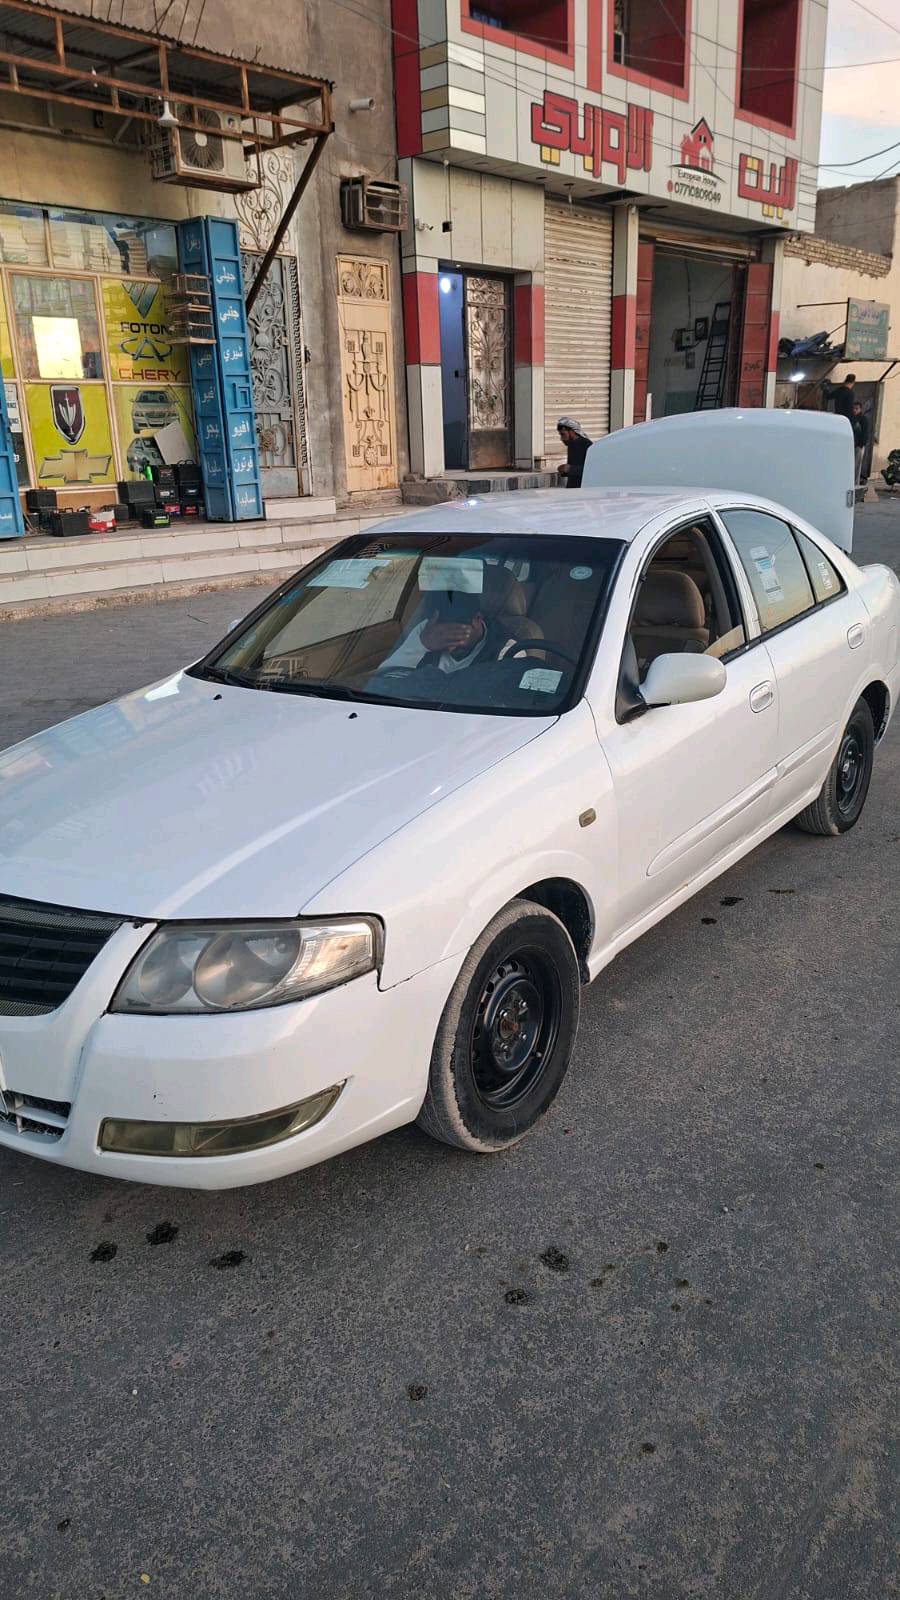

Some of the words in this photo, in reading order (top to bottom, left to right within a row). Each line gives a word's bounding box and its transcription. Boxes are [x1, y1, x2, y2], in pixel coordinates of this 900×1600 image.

[216, 265, 236, 284] جيلي
[121, 321, 173, 336] FOTON
[118, 367, 181, 380] CHERY
